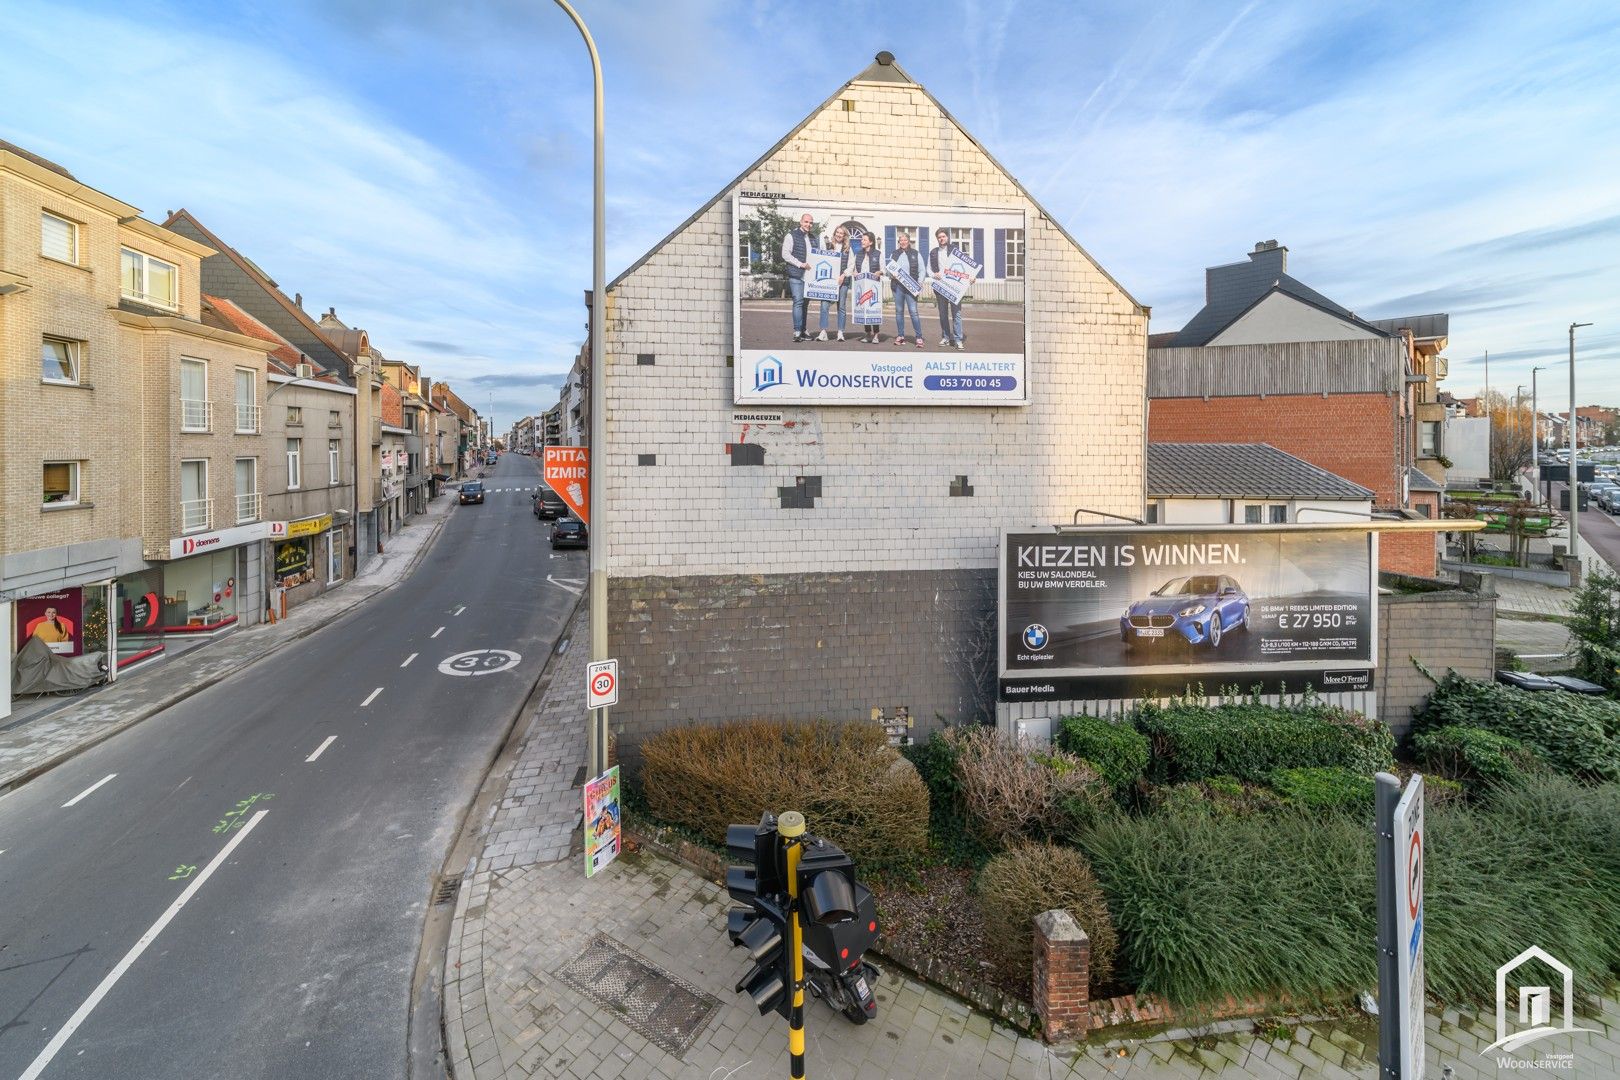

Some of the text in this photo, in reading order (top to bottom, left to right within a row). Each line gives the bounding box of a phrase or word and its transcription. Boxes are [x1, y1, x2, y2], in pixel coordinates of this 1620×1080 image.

[872, 364, 913, 374] Vastgoed
[924, 362, 1016, 371] AALST HAALTERT
[796, 369, 913, 388] WOONSERVICE
[940, 378, 1001, 387] 053 70 00 45
[546, 450, 586, 462] PITTA
[546, 467, 586, 479] IZMIR
[196, 538, 220, 547] daenens
[1018, 544, 1246, 567] KIEZEN IS WINNEN.
[1279, 613, 1341, 628] € 27 950
[454, 656, 506, 668] 30
[597, 680, 609, 689] 30
